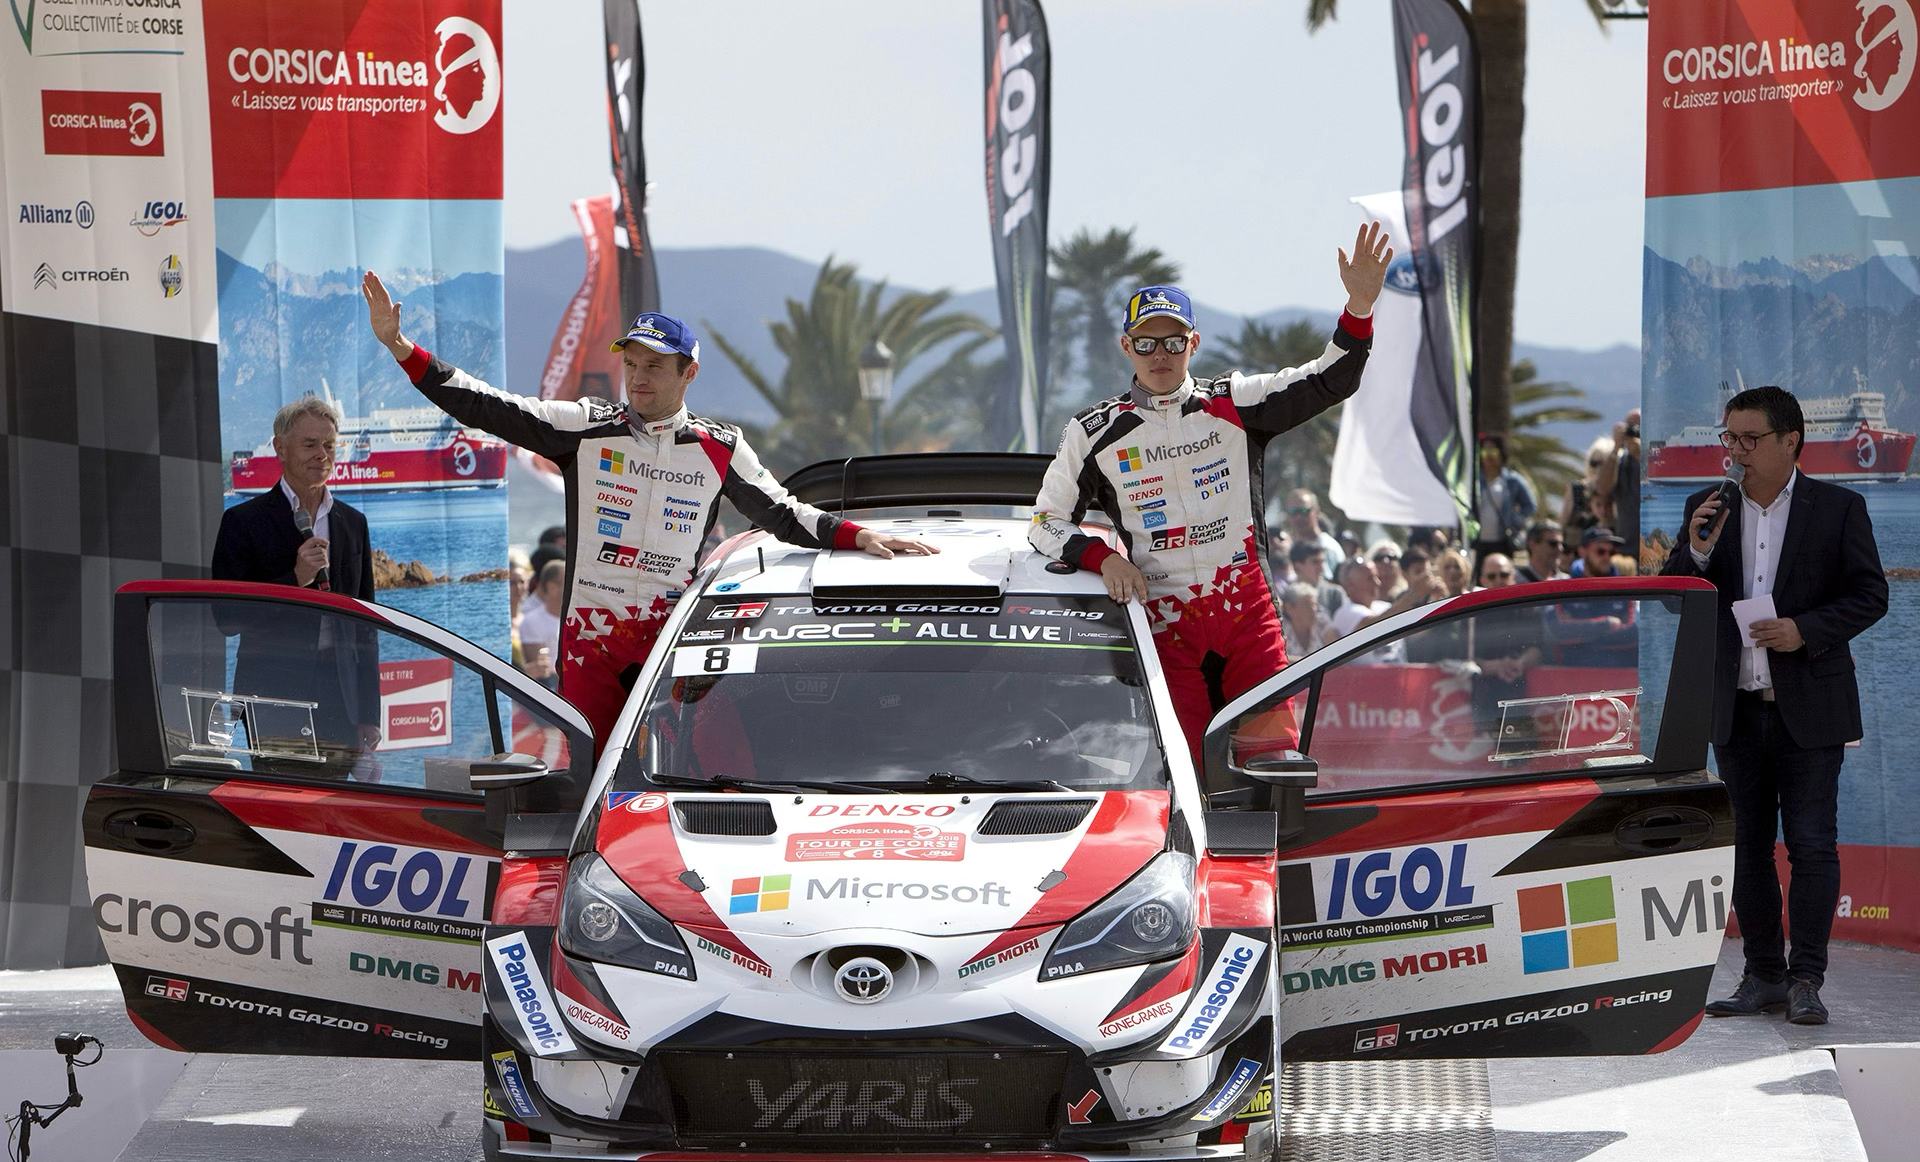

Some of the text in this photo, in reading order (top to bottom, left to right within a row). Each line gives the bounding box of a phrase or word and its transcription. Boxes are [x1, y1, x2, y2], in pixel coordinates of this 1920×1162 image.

[43, 13, 183, 35] COLLECTIVITÉ DE CORSE
[228, 47, 428, 87] CORSICA linea
[1662, 37, 1846, 84] CORSICA linea
[300, 95, 333, 111] vous
[1723, 91, 1756, 104] vous
[49, 114, 127, 129] CORSICA linea
[19, 204, 72, 224] Allianz
[1139, 303, 1181, 315] MICHELIN
[1145, 430, 1222, 464] Microsoft
[629, 459, 706, 487] Microsoft
[1192, 458, 1227, 475] Panasonic
[596, 479, 638, 495] DMG MORI
[1141, 475, 1164, 486] MORI
[1195, 472, 1220, 488] Mobil
[597, 492, 633, 507] DENSO
[1129, 487, 1163, 502] DENSO
[1201, 481, 1229, 500] DELFI
[666, 496, 701, 507] Panasonic
[663, 508, 689, 519] Mobil
[600, 523, 620, 534] ISKU
[1189, 525, 1226, 540] GAZOO
[1190, 516, 1229, 532] TOYOTA
[1189, 532, 1226, 546] Racing
[640, 558, 675, 568] GAZOO
[643, 551, 681, 562] TOYOTA
[637, 564, 671, 576] Racing
[578, 579, 596, 588] Martin
[773, 605, 887, 616] TOYOTA
[896, 604, 999, 614] GAZOO
[1007, 605, 1104, 620] Racing
[916, 623, 977, 638] ALL
[989, 624, 1061, 641] LIVE
[703, 647, 731, 673] 8
[1349, 702, 1422, 728] linea
[808, 804, 956, 817] DENSO
[796, 840, 959, 849] TOUR DE CORSE
[873, 849, 885, 858] 8
[323, 842, 471, 917] IGOL
[1327, 843, 1475, 920] IGOL
[807, 877, 1011, 908] Microsoft
[1641, 874, 1725, 941] Mi
[362, 913, 378, 925] FIA
[381, 916, 411, 929] World
[414, 919, 440, 934] Rally
[1292, 927, 1323, 942] World
[1326, 924, 1352, 938] Rally
[1355, 918, 1429, 936] Championship
[696, 937, 772, 979] DMG MORI
[958, 938, 1040, 979] DMG MORI
[351, 952, 440, 985] DMG
[655, 961, 689, 977] PIAA
[1048, 961, 1085, 978] PIAA
[1283, 943, 1488, 995] DMG MORI
[499, 942, 563, 1050] Panasonic
[1168, 945, 1253, 1050] Panasonic
[195, 991, 283, 1018] TOYOTA
[288, 1009, 369, 1033] GAZOO
[374, 1023, 449, 1049] Racing
[566, 1004, 630, 1041] KONECRANES
[1099, 1001, 1173, 1038] KONECRANES
[1406, 1017, 1499, 1042] TOYOTA
[1506, 1001, 1589, 1026] GAZOO
[1595, 987, 1672, 1010] Racing
[506, 1075, 531, 1114] MICHELIN
[1214, 1067, 1251, 1110] MICHELIN
